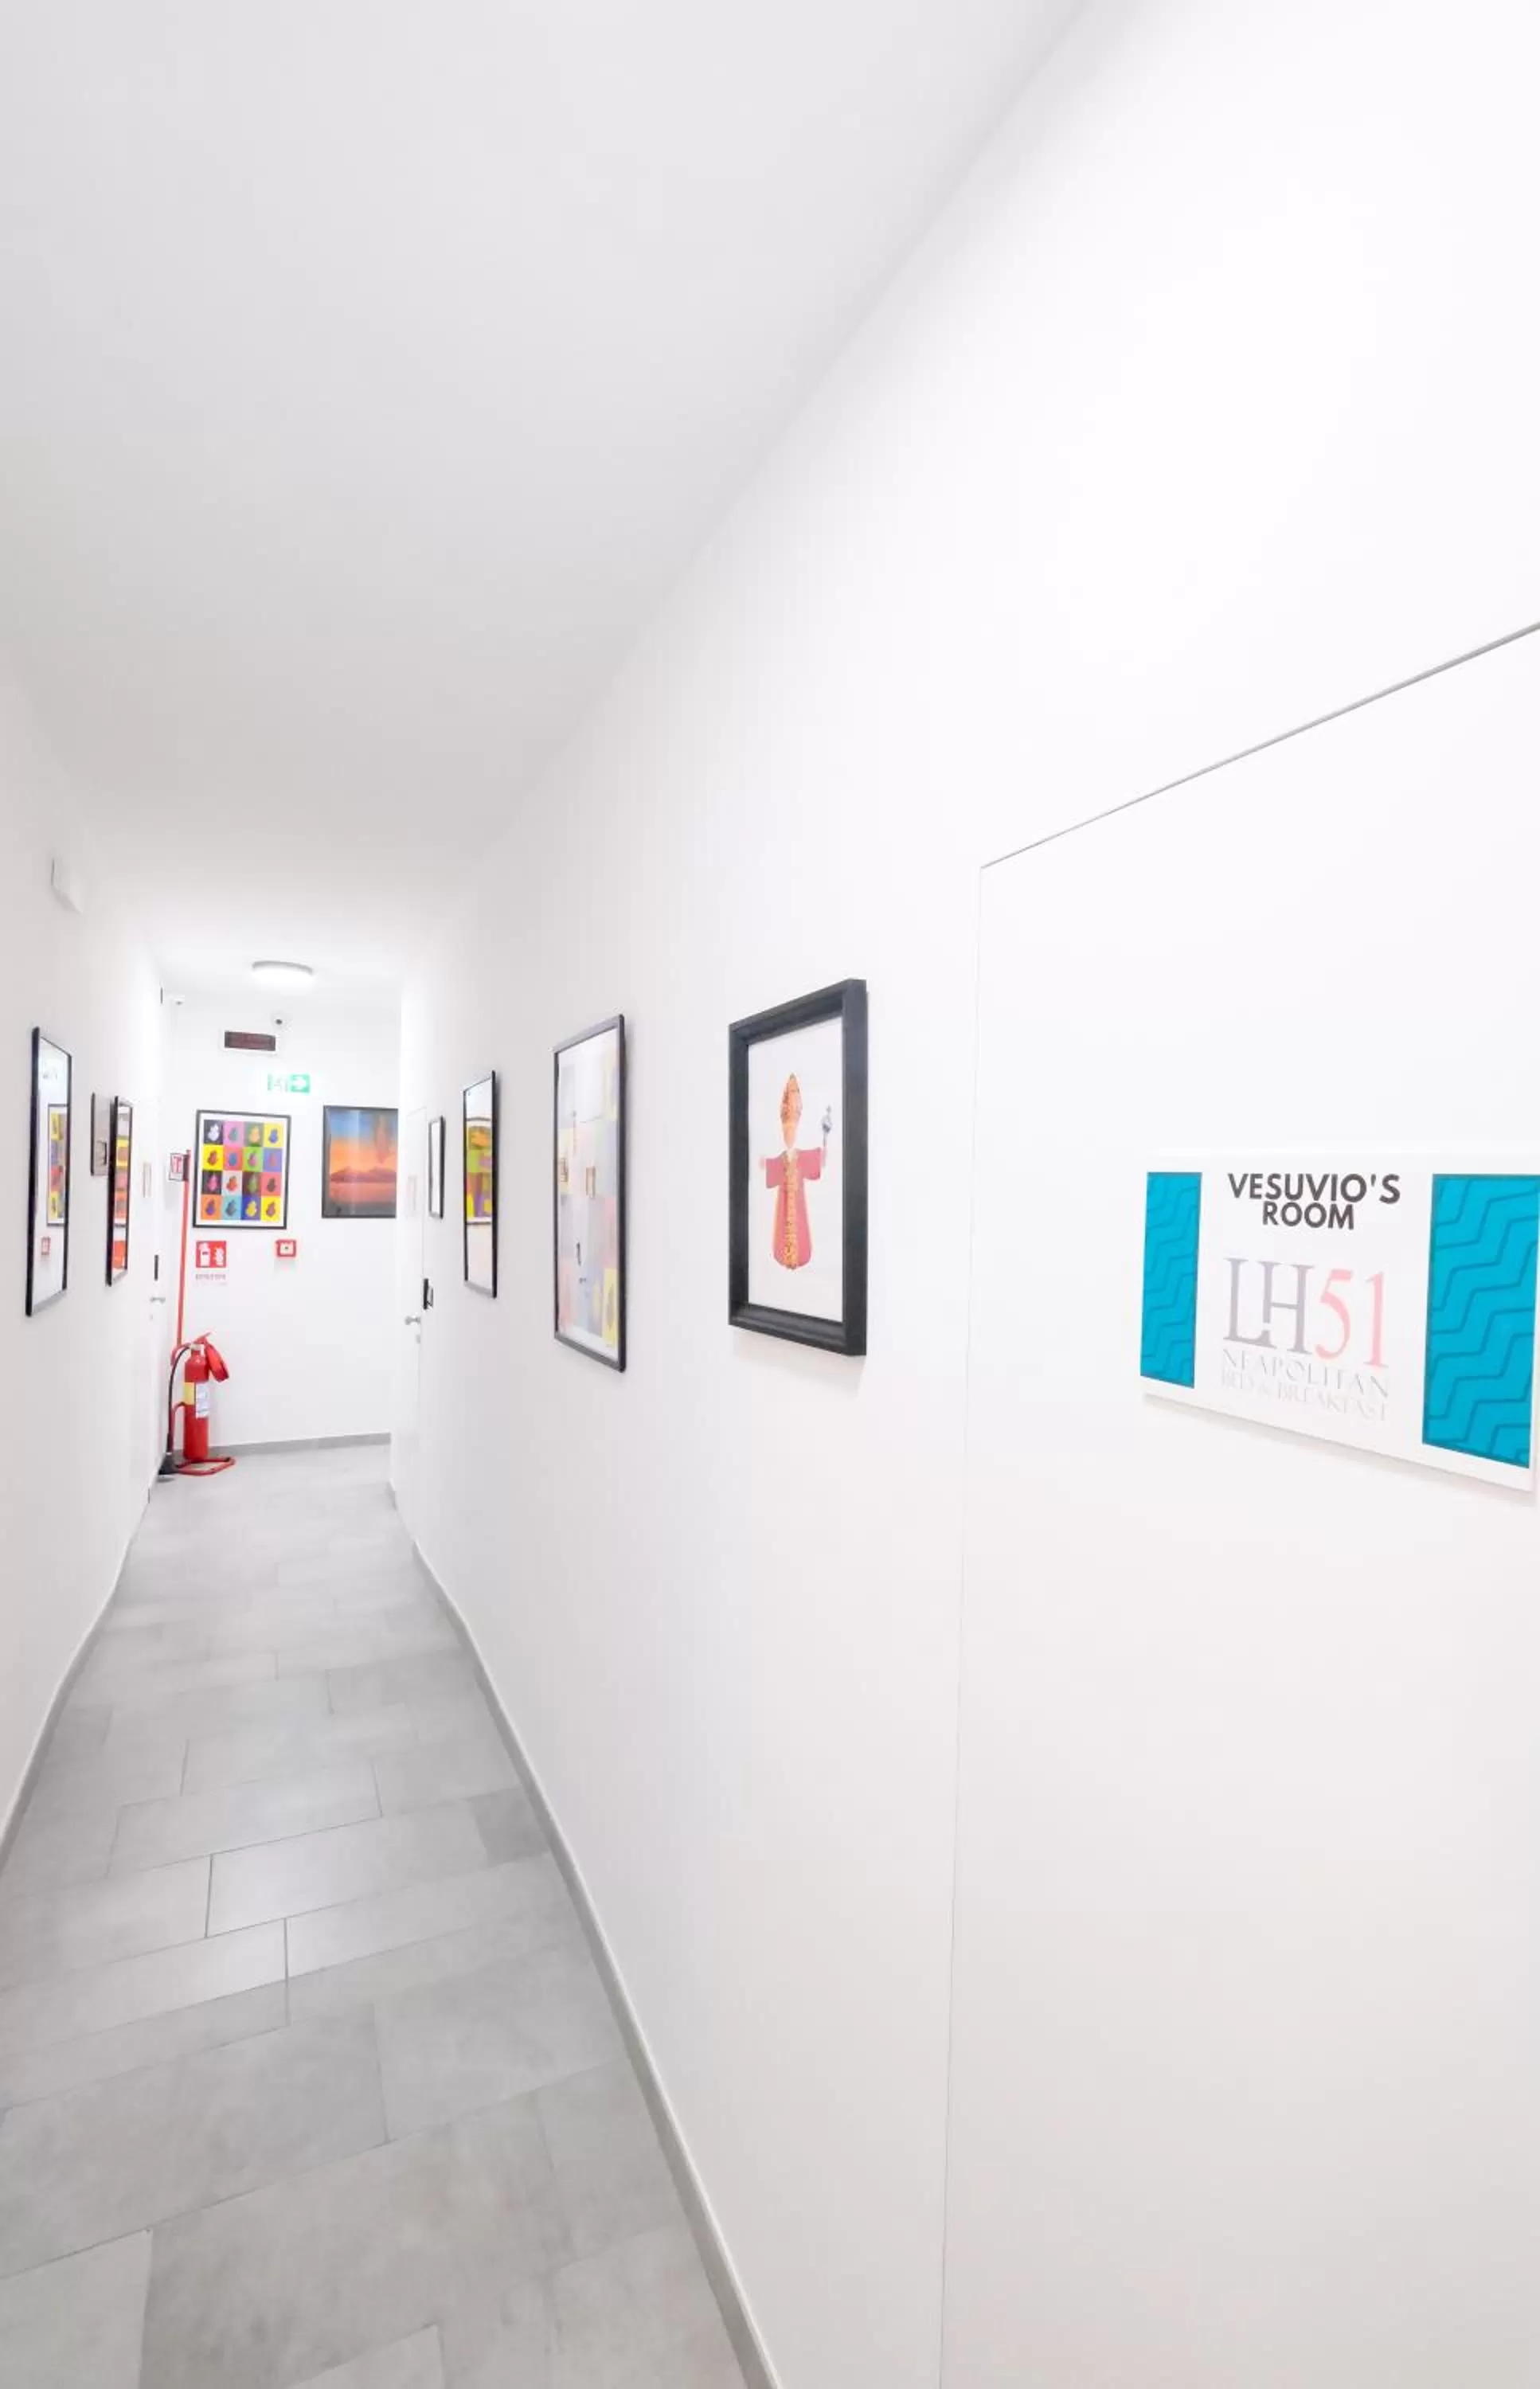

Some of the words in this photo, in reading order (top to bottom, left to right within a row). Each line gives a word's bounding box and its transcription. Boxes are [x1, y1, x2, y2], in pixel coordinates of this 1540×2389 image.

[1227, 1172, 1401, 1205] VESUVIO'S
[1262, 1201, 1354, 1230] ROOM
[1222, 1257, 1390, 1369] LH51
[1222, 1348, 1390, 1399] NEAPOLITAN
